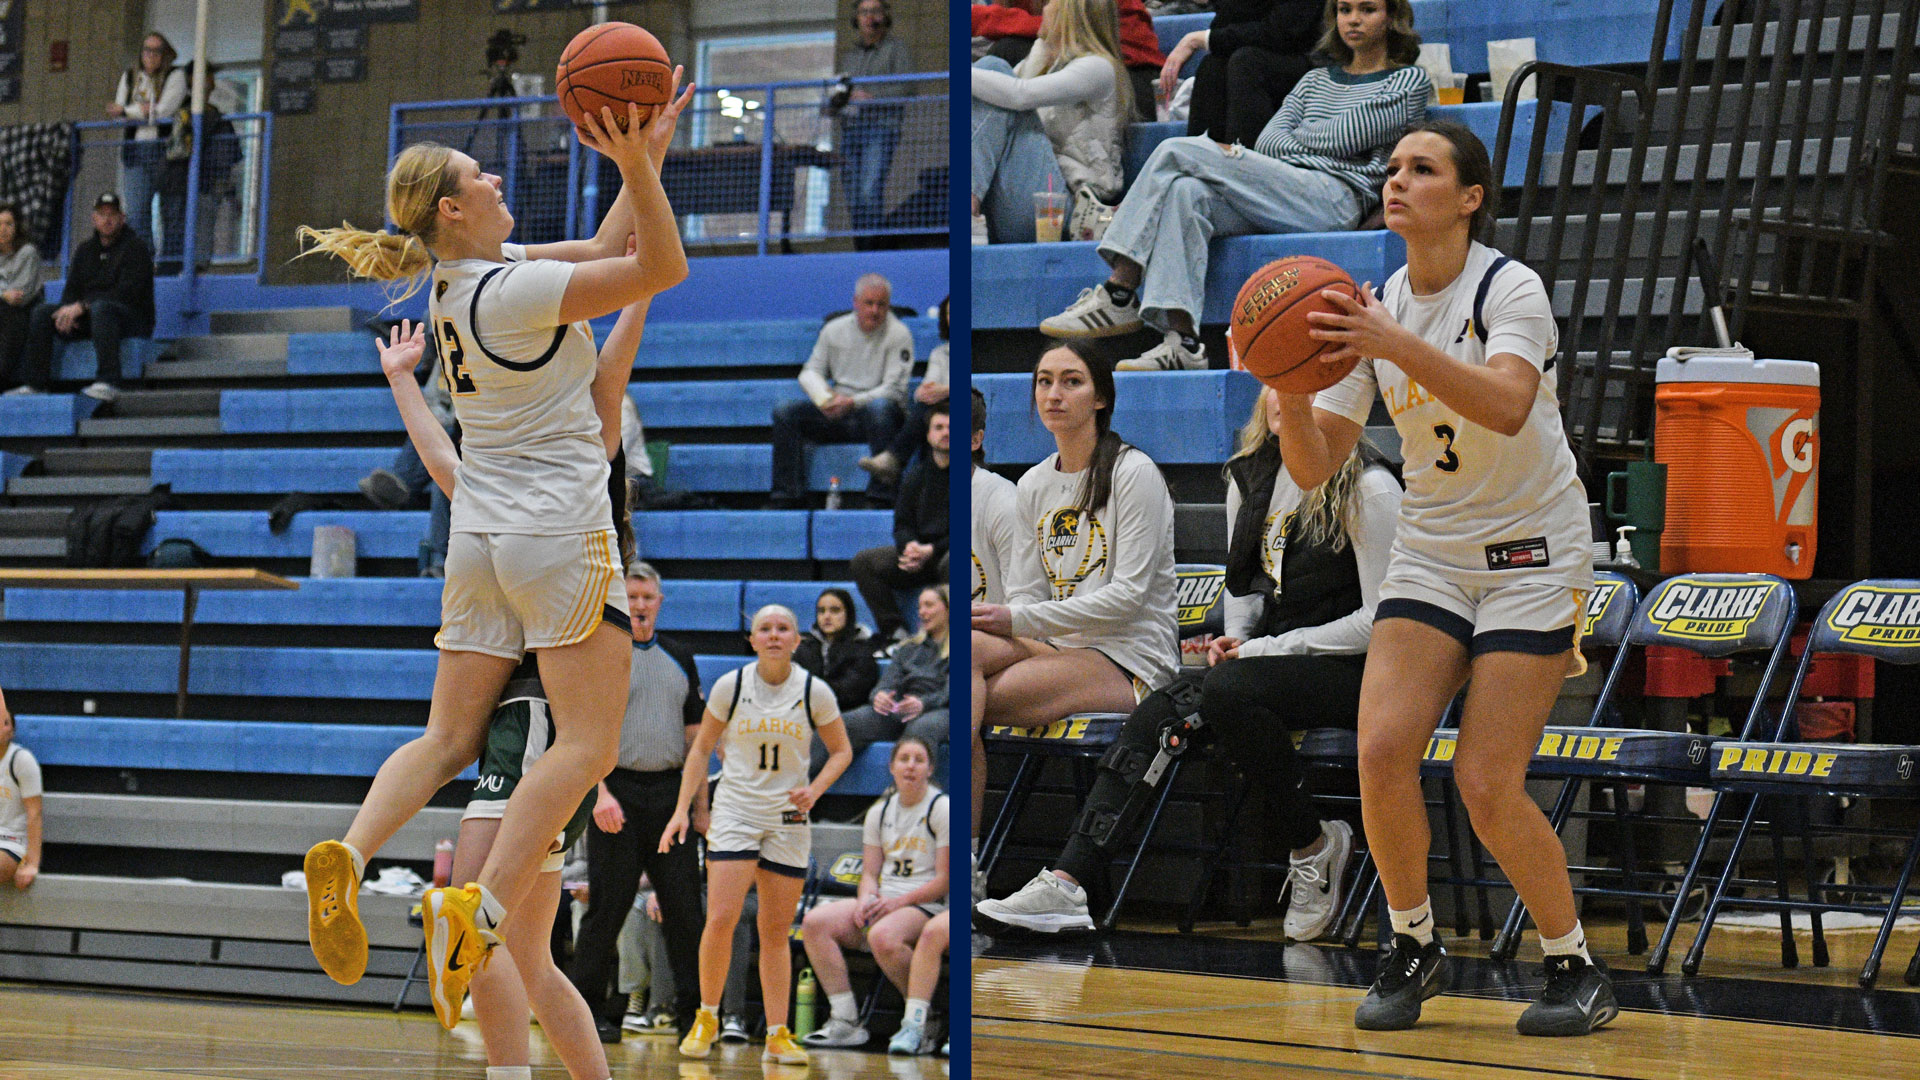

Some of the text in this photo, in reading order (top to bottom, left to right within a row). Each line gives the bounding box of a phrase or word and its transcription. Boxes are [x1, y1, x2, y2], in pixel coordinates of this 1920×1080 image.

[1237, 267, 1300, 326] LEGACY
[1431, 421, 1462, 474] 3
[1781, 418, 1813, 473] G
[1654, 584, 1769, 620] CLARKE
[1834, 590, 1920, 627] CLAR
[1684, 621, 1735, 633] PRIDE
[737, 717, 803, 741] CLARKE
[759, 742, 780, 771] 11
[1535, 733, 1625, 761] RIDE
[1717, 747, 1838, 777] PRIDE
